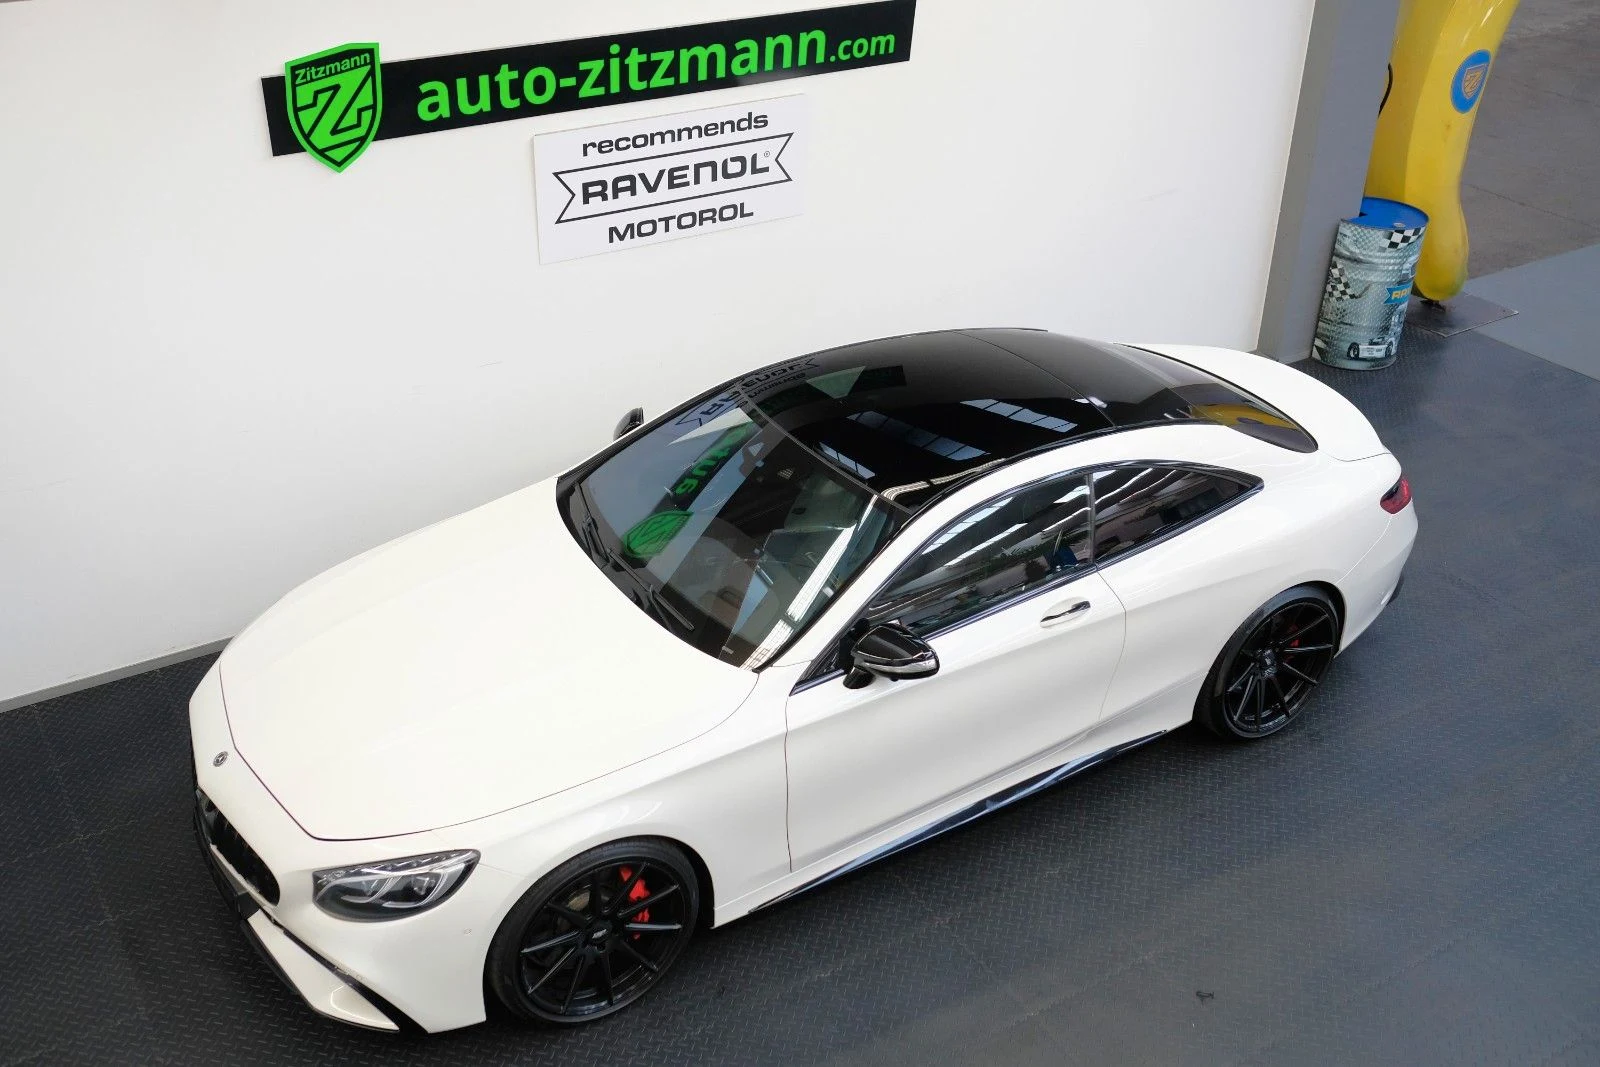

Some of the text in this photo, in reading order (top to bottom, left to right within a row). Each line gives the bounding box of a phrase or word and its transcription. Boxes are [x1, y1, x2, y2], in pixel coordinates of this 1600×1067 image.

[295, 52, 371, 85] Zitzmann
[416, 29, 897, 122] auto-zitzmann.com
[582, 112, 769, 157] recommends
[608, 202, 754, 244] MOTOROL
